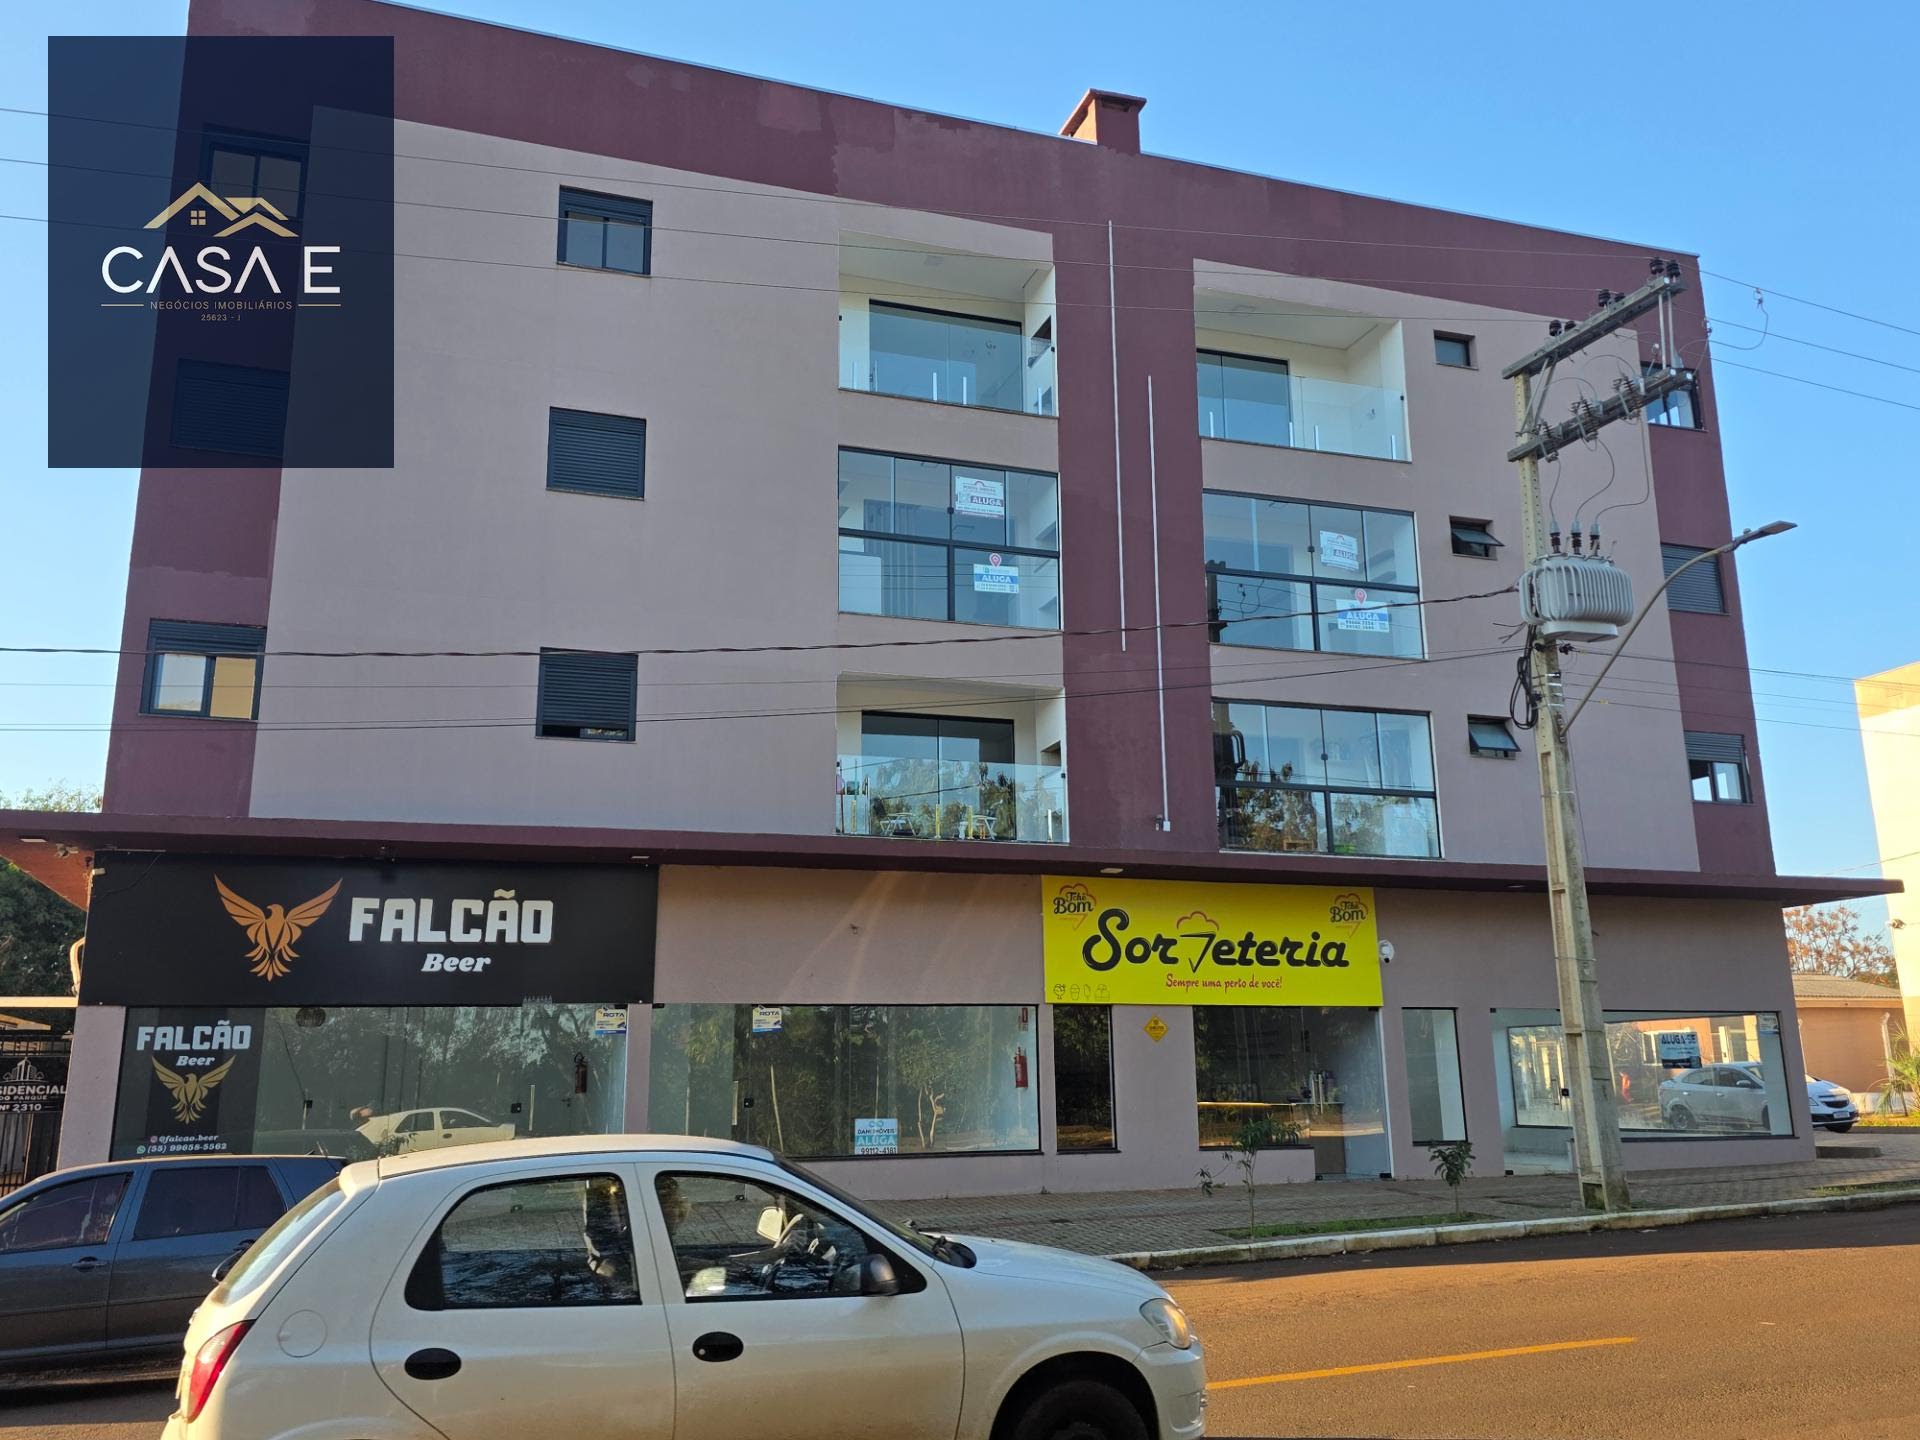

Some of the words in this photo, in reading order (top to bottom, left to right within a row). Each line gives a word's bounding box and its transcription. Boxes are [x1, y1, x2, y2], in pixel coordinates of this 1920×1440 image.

[981, 574, 1012, 584] ALUGA
[1346, 611, 1380, 620] ALUGA
[1053, 896, 1094, 915] Bom
[348, 888, 555, 945] FALCÃO
[1329, 906, 1367, 923] Bom
[420, 953, 492, 973] Beer
[1166, 973, 1200, 993] Sempre
[1202, 979, 1222, 988] uma
[1224, 977, 1247, 994] perto
[1249, 973, 1260, 988] de
[136, 1019, 252, 1051] FALCÃO
[176, 1055, 216, 1067] Beer
[0, 1085, 66, 1096] IDENCIAL
[12, 1103, 42, 1112] 2310
[158, 1133, 220, 1144] @falcao.beer
[856, 1134, 897, 1146] ALUGA
[147, 1144, 167, 1154] (55)
